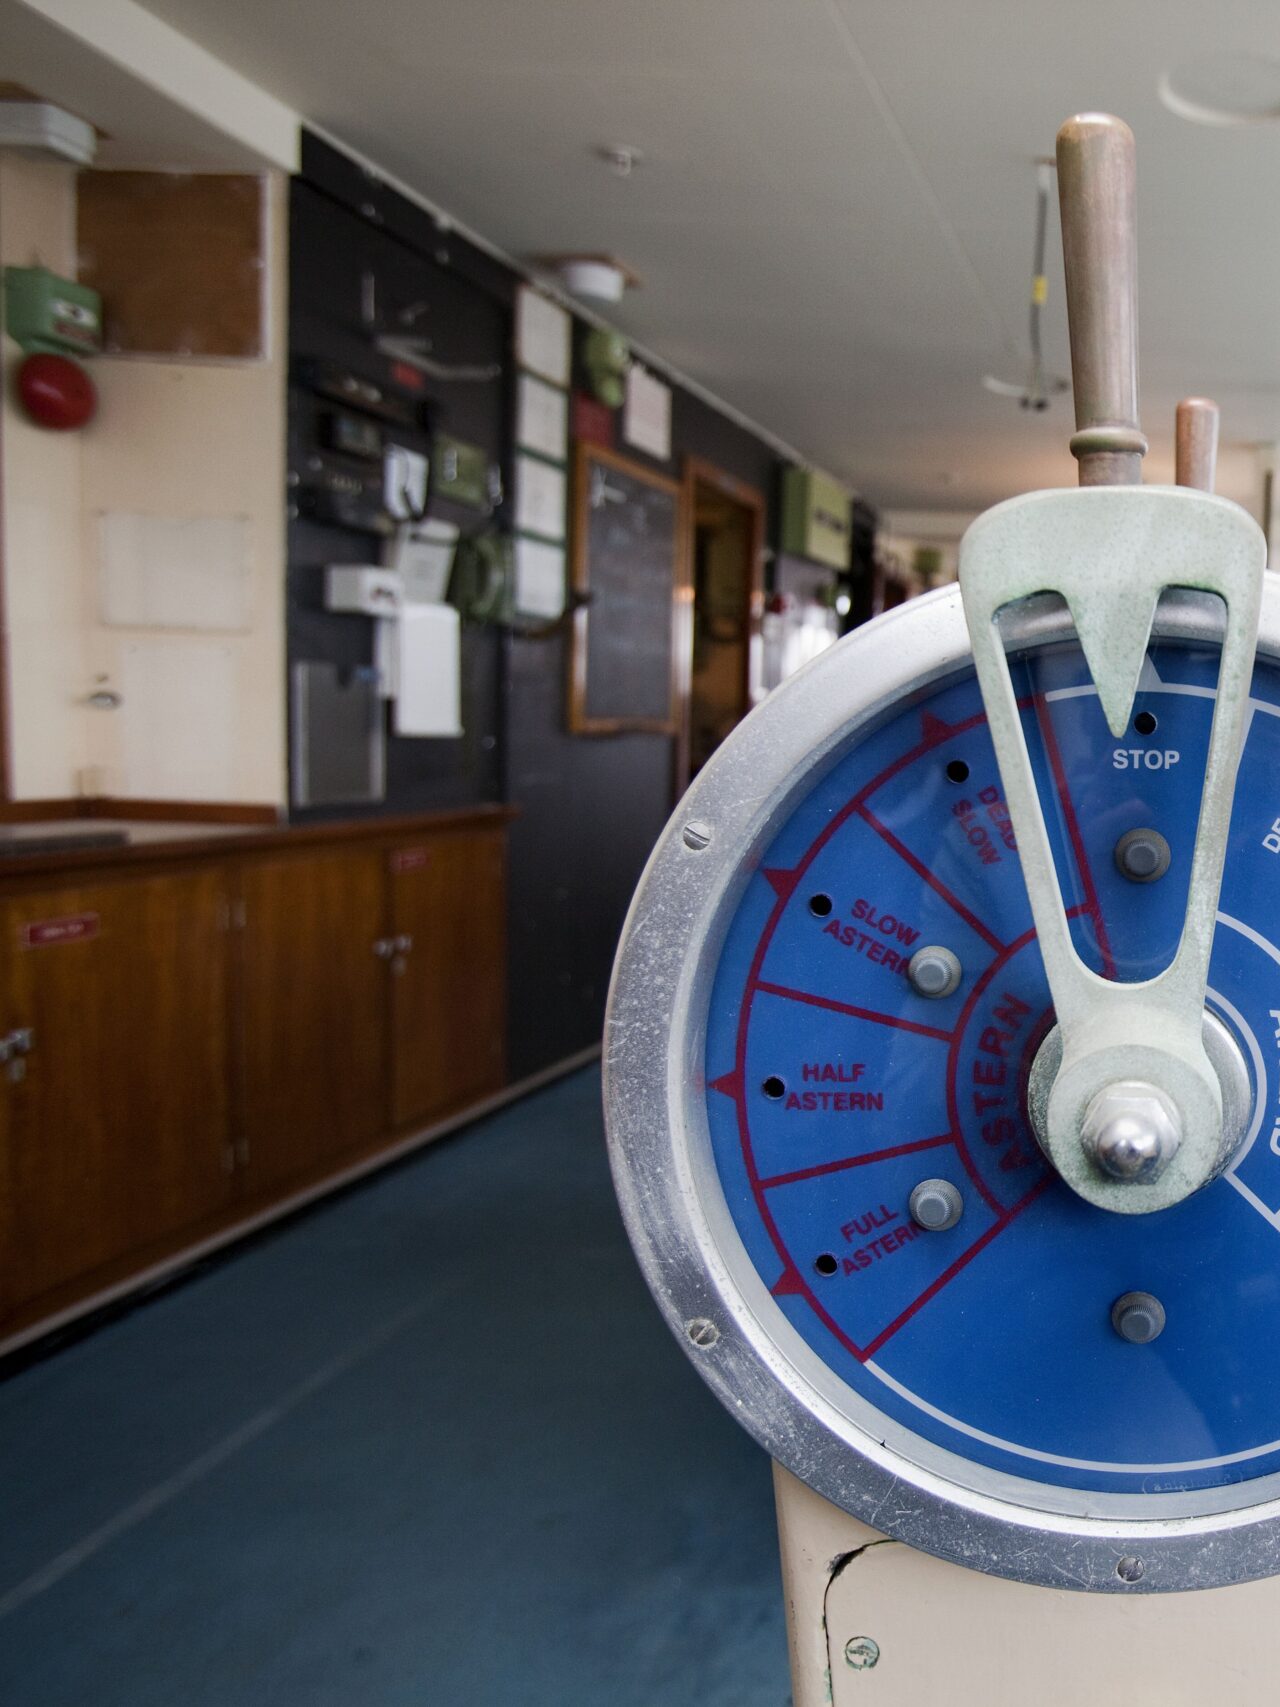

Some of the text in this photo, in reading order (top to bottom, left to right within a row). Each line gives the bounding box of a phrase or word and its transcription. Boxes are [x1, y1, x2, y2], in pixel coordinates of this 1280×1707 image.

[1113, 749, 1180, 770] STOP
[952, 799, 1002, 865] SLOW
[851, 898, 921, 946] SLOW
[802, 1064, 866, 1082] HALF
[973, 992, 1033, 1172] ASTERN
[784, 1091, 884, 1111] ASTERN
[840, 1204, 899, 1243] FULL
